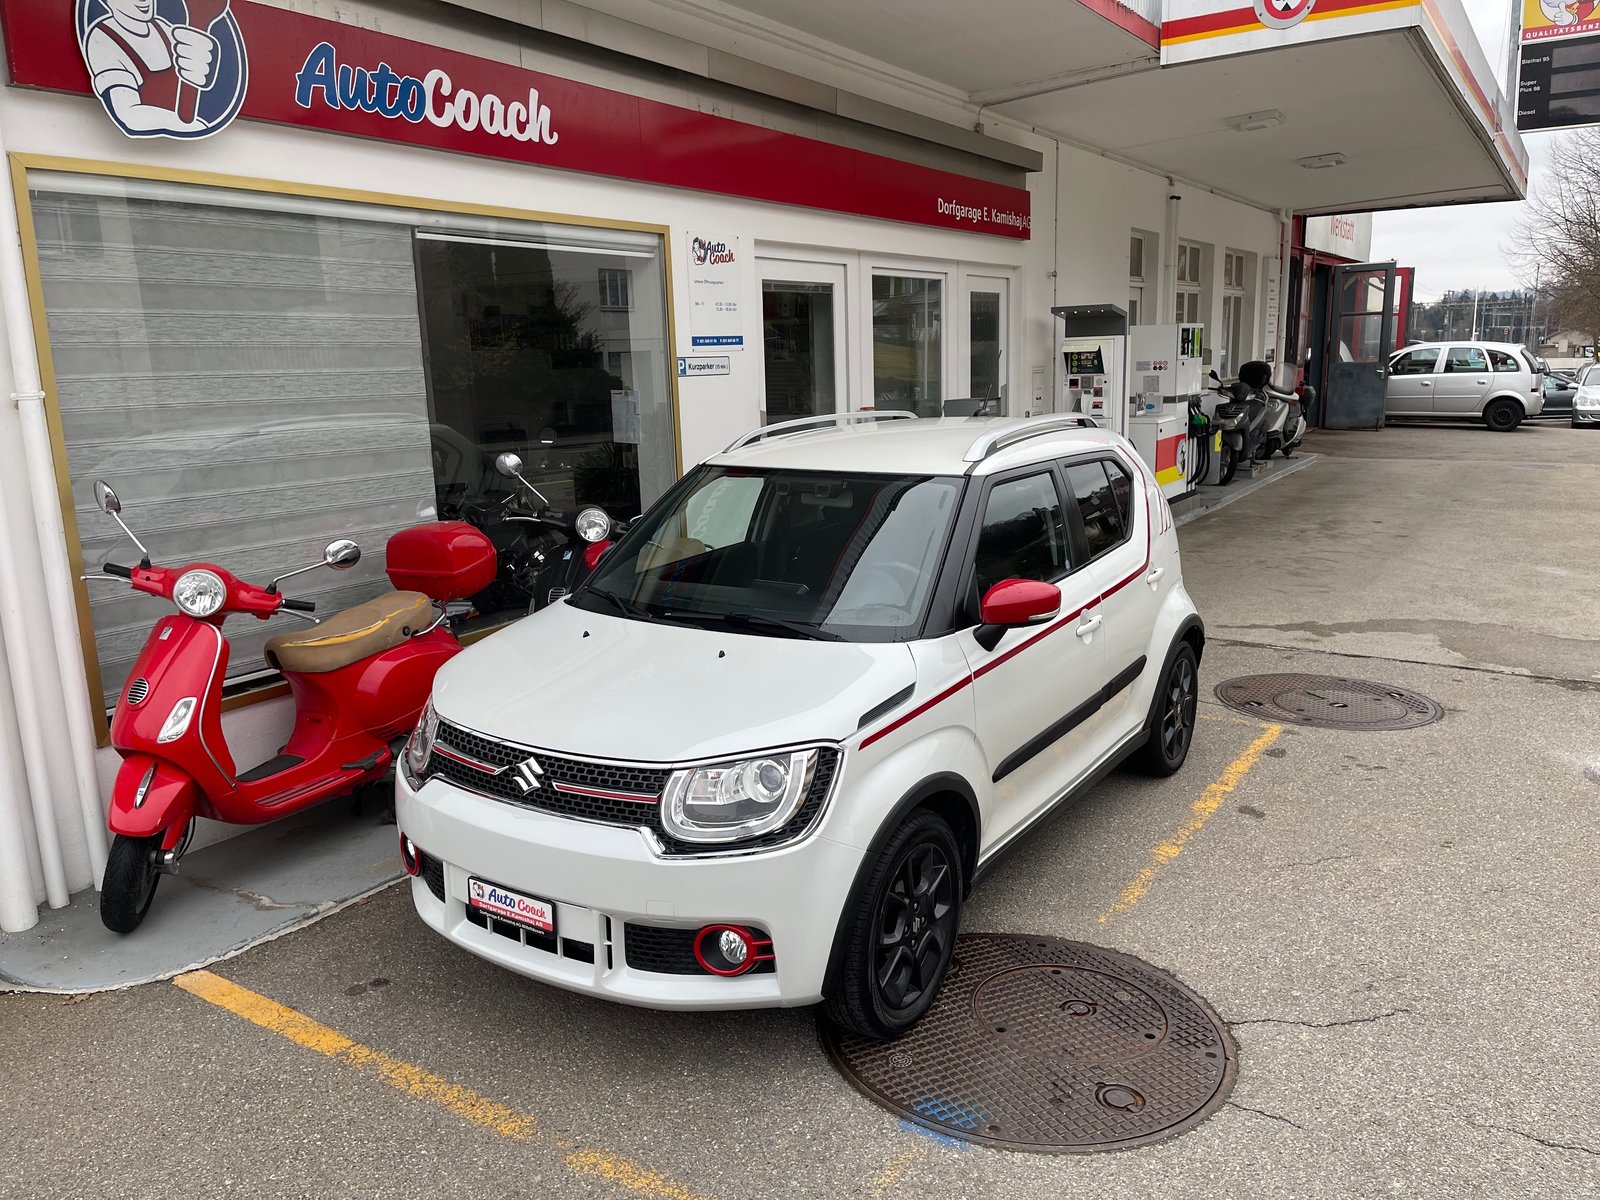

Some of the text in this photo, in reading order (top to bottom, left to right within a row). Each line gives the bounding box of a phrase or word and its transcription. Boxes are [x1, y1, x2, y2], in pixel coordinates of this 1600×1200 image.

[1521, 57, 1542, 65] Bleifrei
[937, 198, 981, 223] Dorfgarage
[983, 207, 990, 221] E.
[991, 208, 1022, 230] Kamishaj
[1330, 215, 1355, 241] Werkstatt
[706, 241, 726, 253] Auto
[709, 250, 735, 265] Coach
[688, 363, 714, 371] Kurzparker
[478, 901, 507, 915] Dorfgarage
[488, 888, 546, 918] Auto Coach
